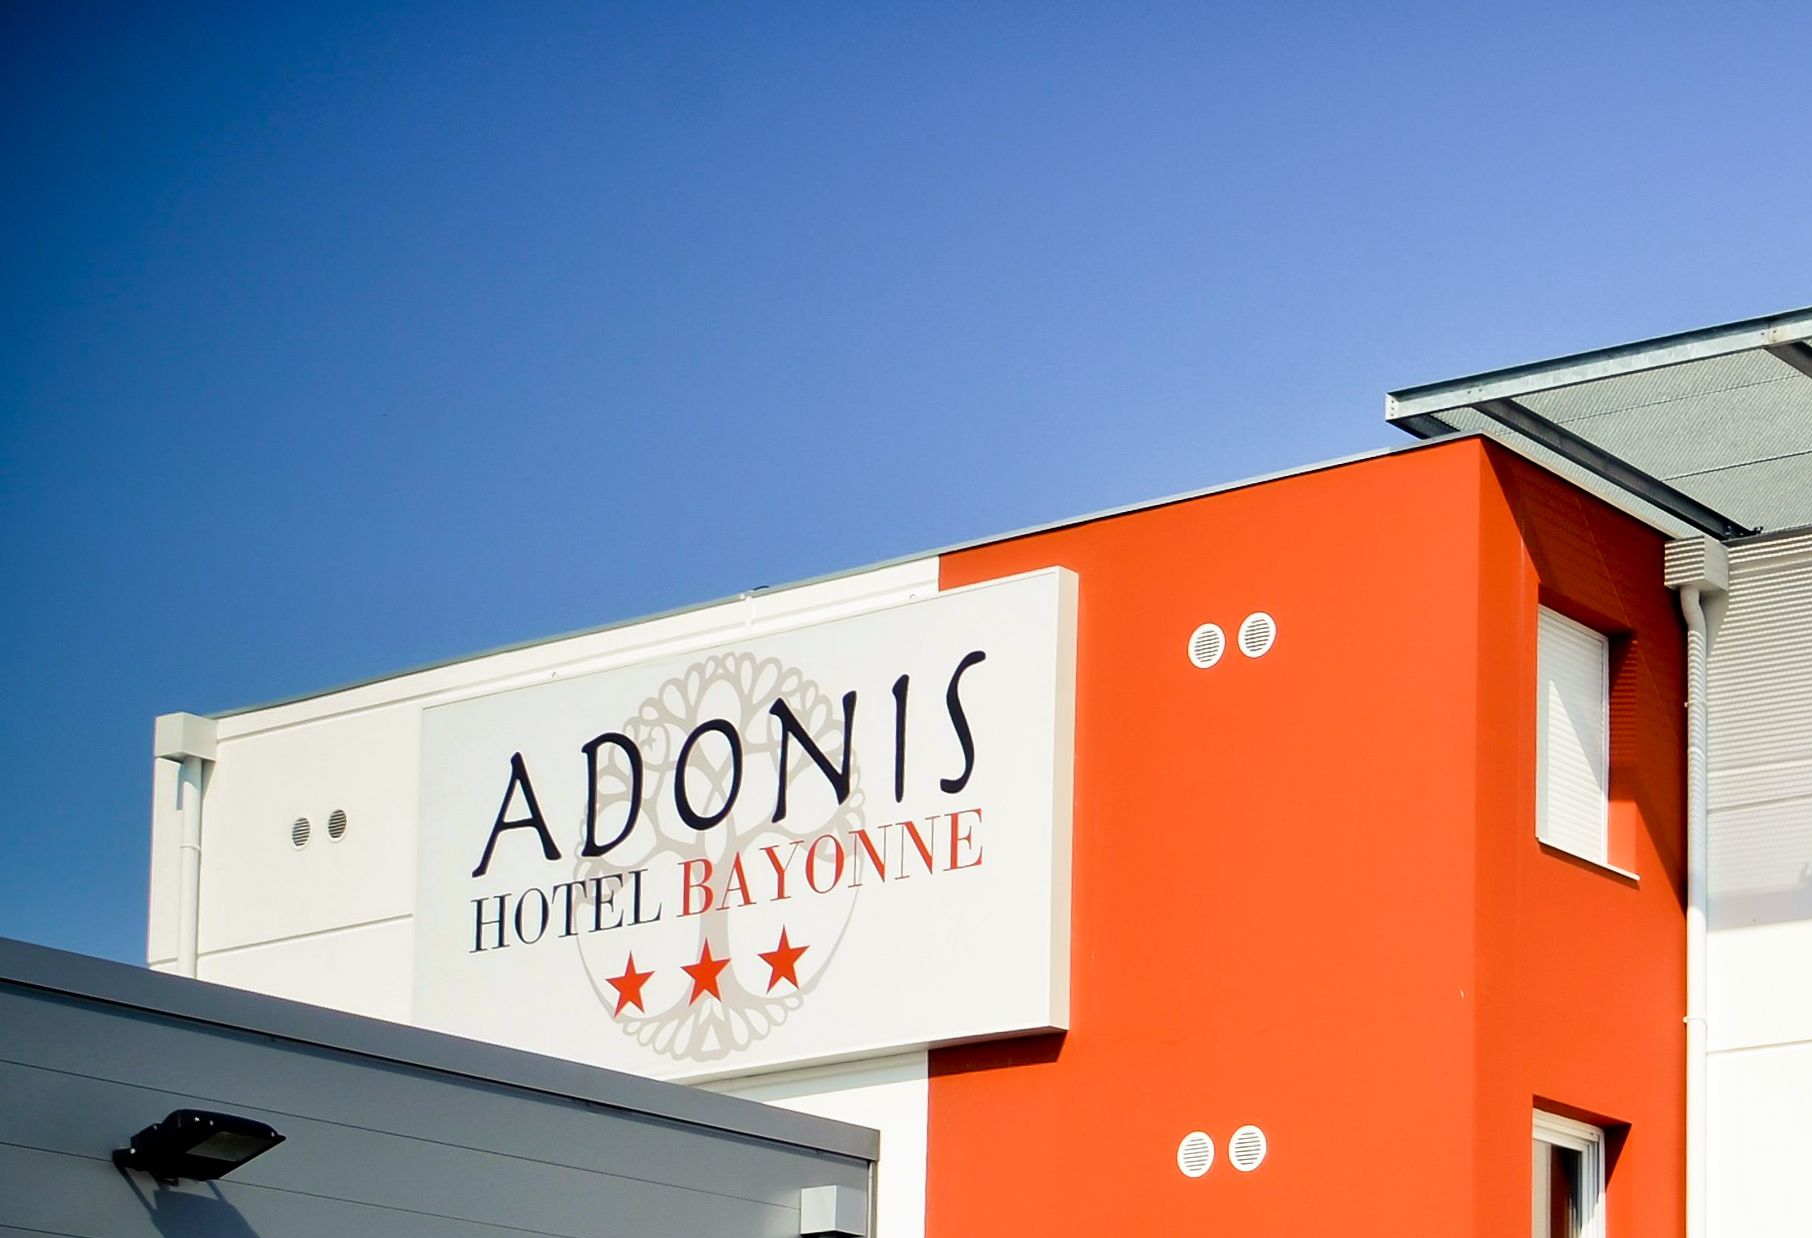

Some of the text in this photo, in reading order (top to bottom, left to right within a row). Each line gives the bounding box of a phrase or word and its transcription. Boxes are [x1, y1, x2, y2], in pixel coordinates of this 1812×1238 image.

[472, 650, 986, 877] ADONIS
[468, 808, 984, 953] HOTEL BAYONNE
